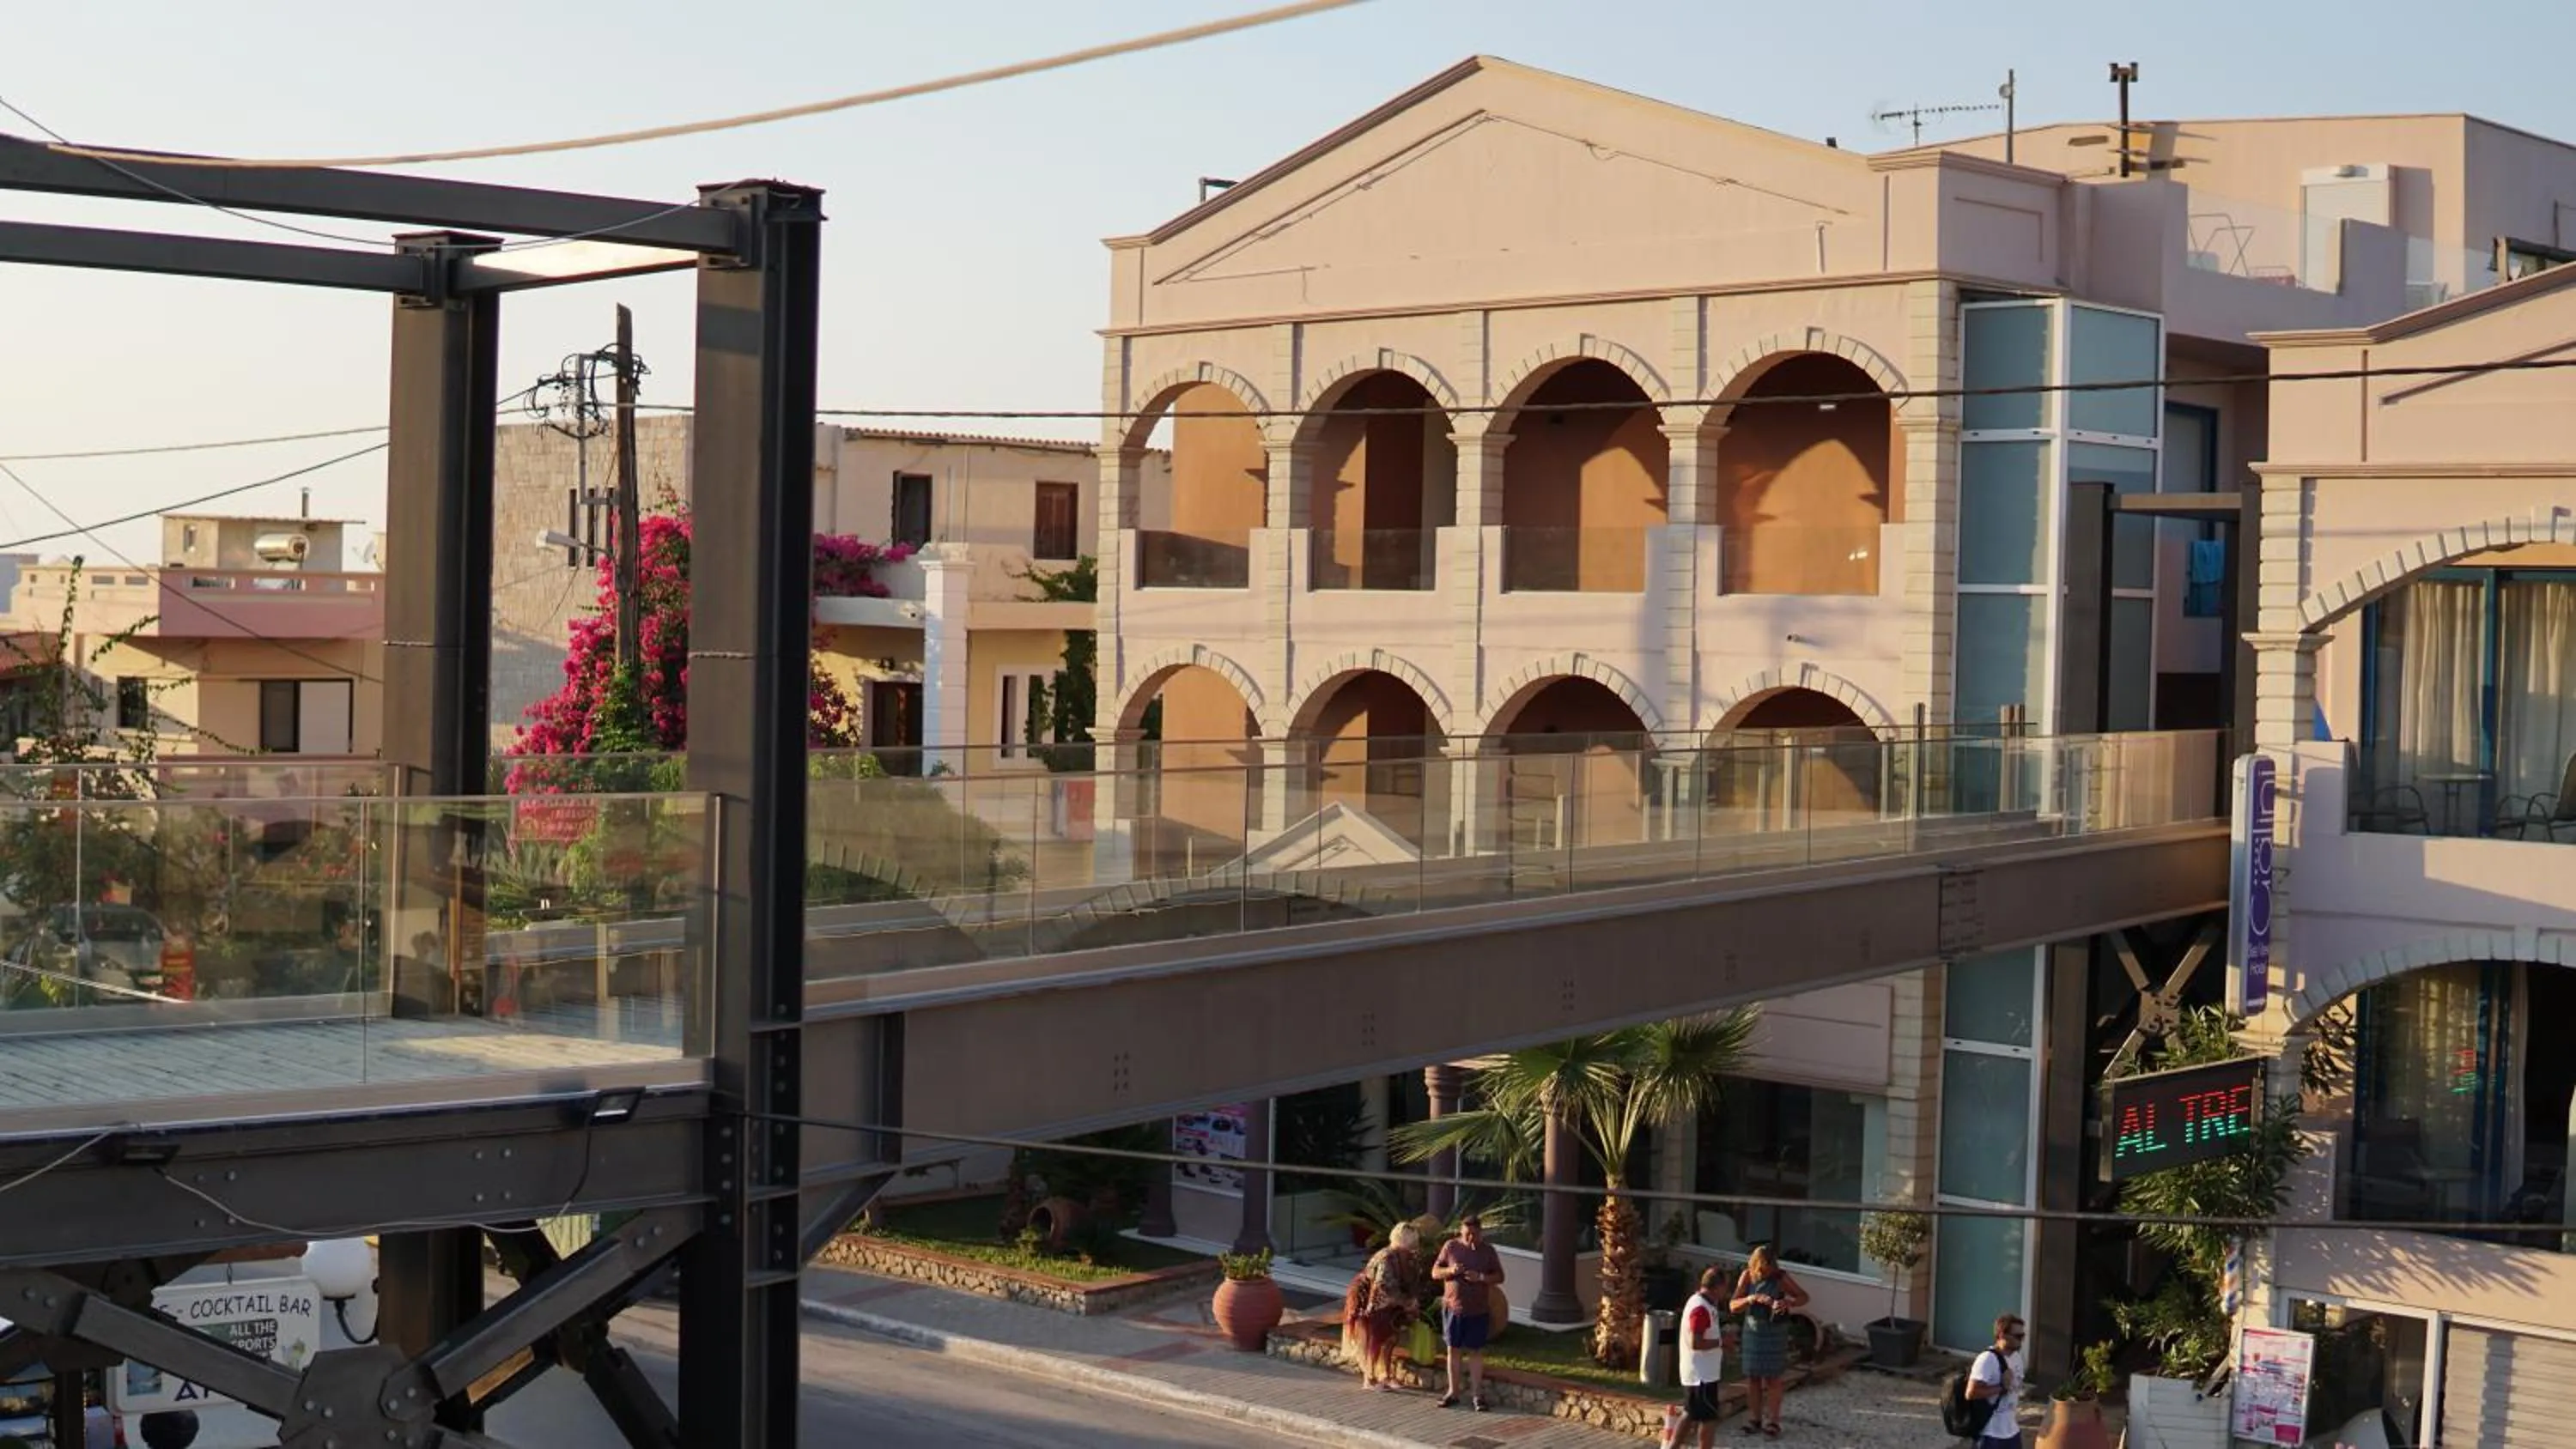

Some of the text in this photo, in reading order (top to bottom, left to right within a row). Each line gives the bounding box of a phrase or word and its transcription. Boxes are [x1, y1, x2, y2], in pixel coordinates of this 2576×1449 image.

[2115, 1101, 2167, 1158] AL
[190, 1294, 273, 1319] COCKTAIL
[279, 1294, 312, 1318] BAR
[229, 1320, 276, 1337] ALL THE
